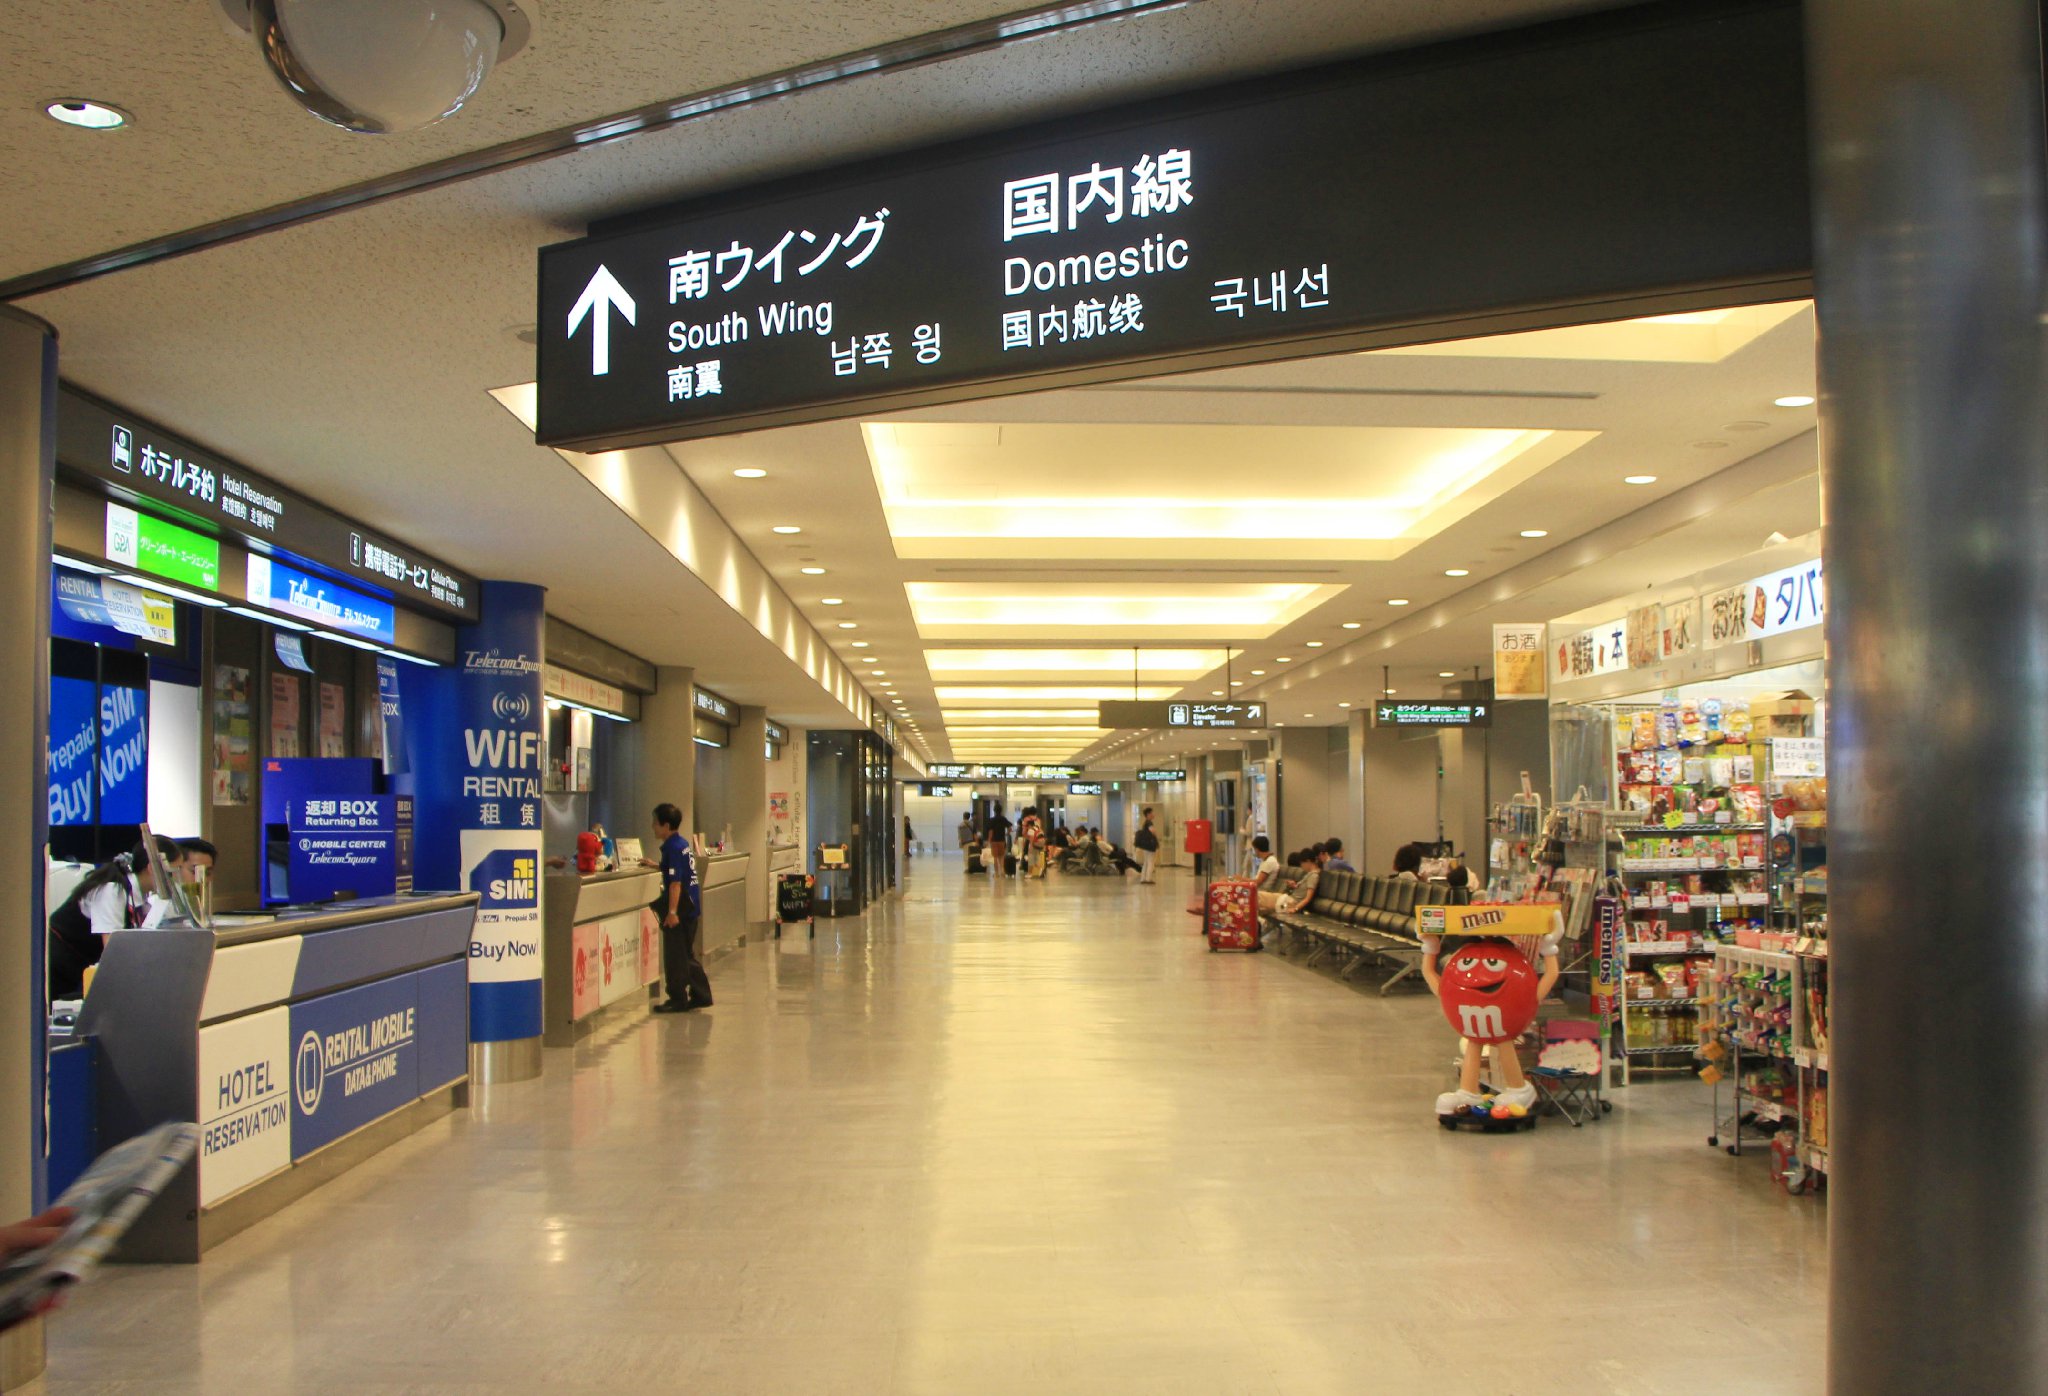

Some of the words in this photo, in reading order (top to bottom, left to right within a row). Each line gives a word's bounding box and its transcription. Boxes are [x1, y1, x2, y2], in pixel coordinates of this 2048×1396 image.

[1002, 148, 1194, 242] 国内線
[667, 207, 891, 304] 南ウイング
[1003, 233, 1190, 296] Domestic
[1209, 263, 1330, 318] 국내선
[667, 311, 749, 353] South
[758, 300, 834, 337] Wing
[1002, 294, 1145, 351] 国内航线
[830, 332, 893, 377] 남쪽
[910, 323, 942, 365] 윙
[667, 360, 723, 402] 南翼
[140, 443, 216, 503] ホテル予約
[222, 473, 242, 497] Hotel
[242, 482, 283, 515] Reservation
[60, 576, 100, 599] RENTAL
[364, 541, 430, 591] 携帯電話サービス
[1502, 632, 1537, 650] お酒
[101, 686, 135, 738] SIM
[1192, 704, 1242, 713] エレベーター
[49, 717, 97, 774] repaid
[464, 728, 541, 770] WiFi
[49, 769, 93, 826] Buy
[305, 800, 336, 815] 返却
[339, 800, 379, 815] BOX
[463, 776, 541, 798] RENTAL
[305, 817, 356, 828] Returning
[358, 817, 379, 826] Box
[312, 841, 347, 849] MOBILE
[348, 841, 386, 849] CENTER
[308, 852, 377, 866] TelecomSquare
[488, 879, 529, 900] SIM
[469, 941, 506, 962] Buy
[1600, 906, 1614, 985] mentos
[325, 1029, 370, 1069] RENTAL
[370, 1007, 415, 1051] MOBILE
[1458, 1004, 1507, 1038] m
[218, 1060, 275, 1110] HOTEL
[344, 1053, 398, 1096] DATA&PHONE
[204, 1100, 287, 1156] RESERVATION
